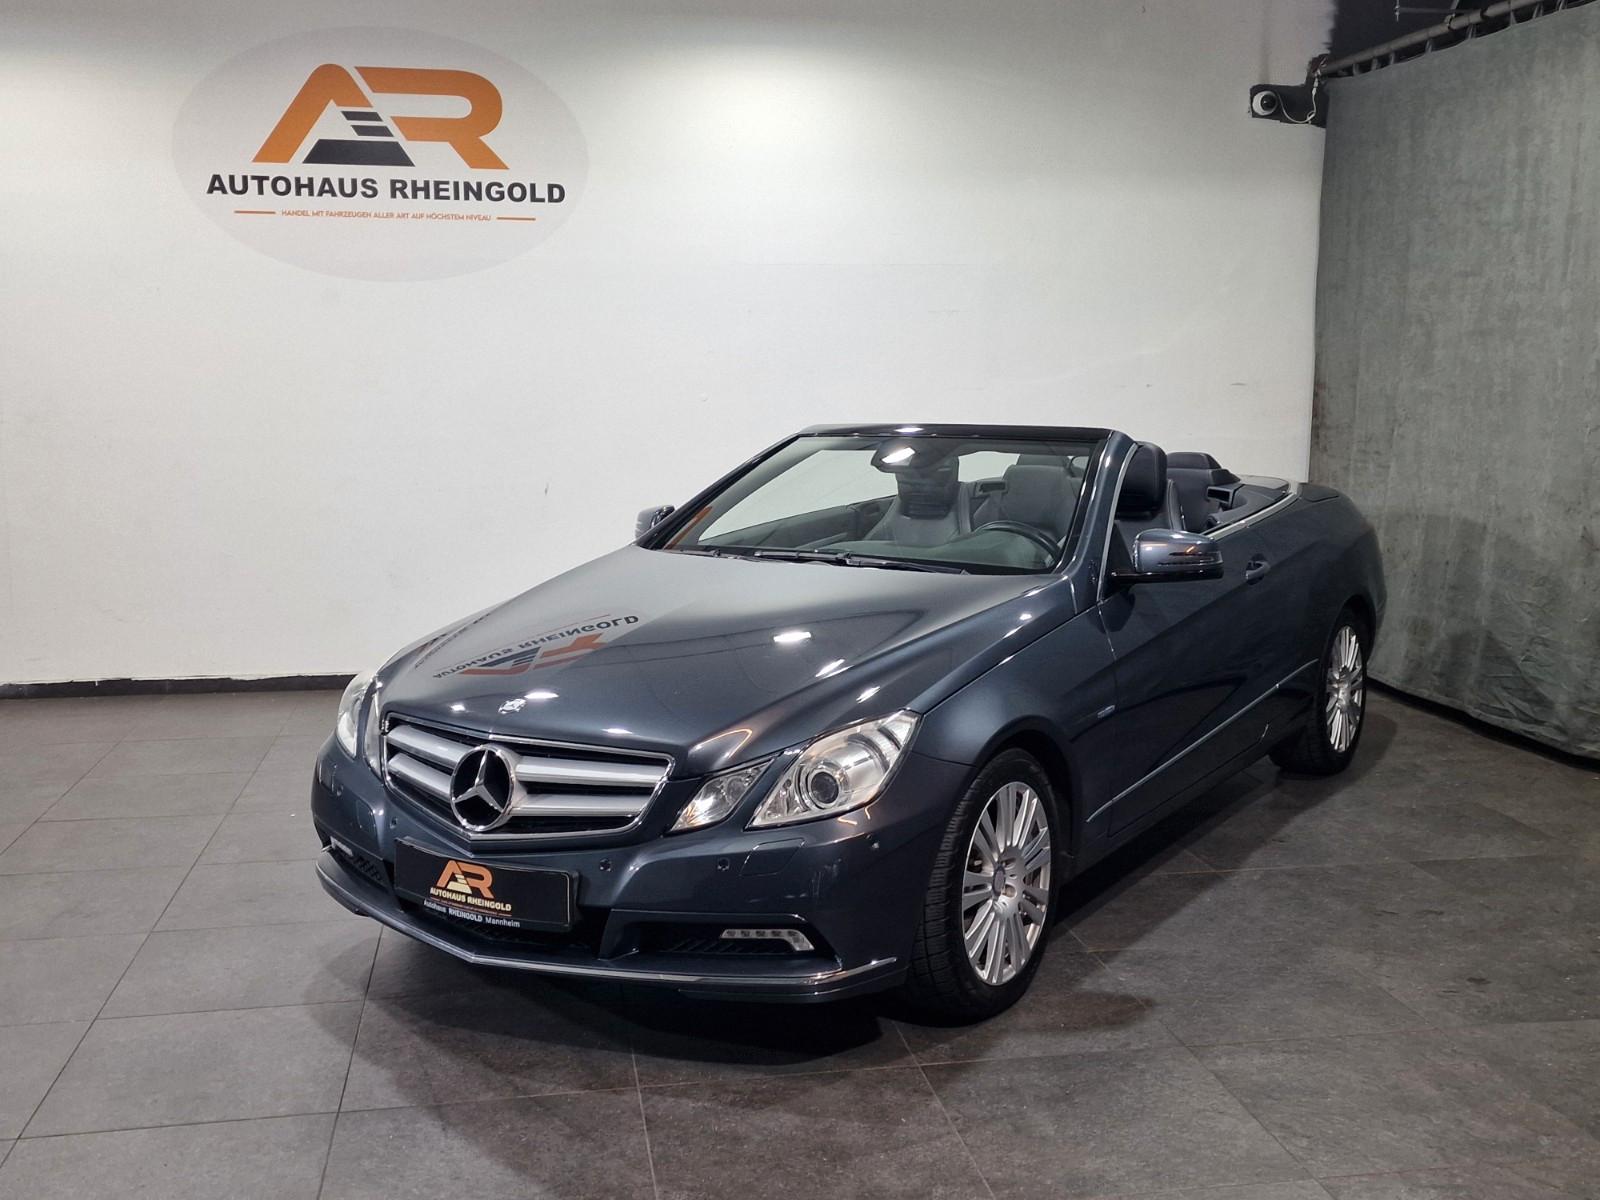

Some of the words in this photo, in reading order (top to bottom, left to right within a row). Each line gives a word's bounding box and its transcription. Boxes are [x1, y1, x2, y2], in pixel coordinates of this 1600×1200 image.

[251, 63, 510, 170] AR
[206, 173, 379, 198] AUTOHAUS
[389, 178, 566, 203] RHEINGOLD
[281, 209, 310, 217] HANDEL
[325, 210, 371, 218] FAHRZEUGEN
[373, 211, 395, 219] ALLER
[411, 212, 425, 220] AUF
[426, 211, 465, 221] HÖCHSTEM
[436, 860, 495, 899] AR
[423, 899, 447, 913] Autohaus
[448, 907, 483, 922] RHEINGOLD
[485, 916, 520, 928] Mannheim
[429, 887, 467, 903] AUTOHAUS
[467, 896, 512, 912] RHEINGOLD
